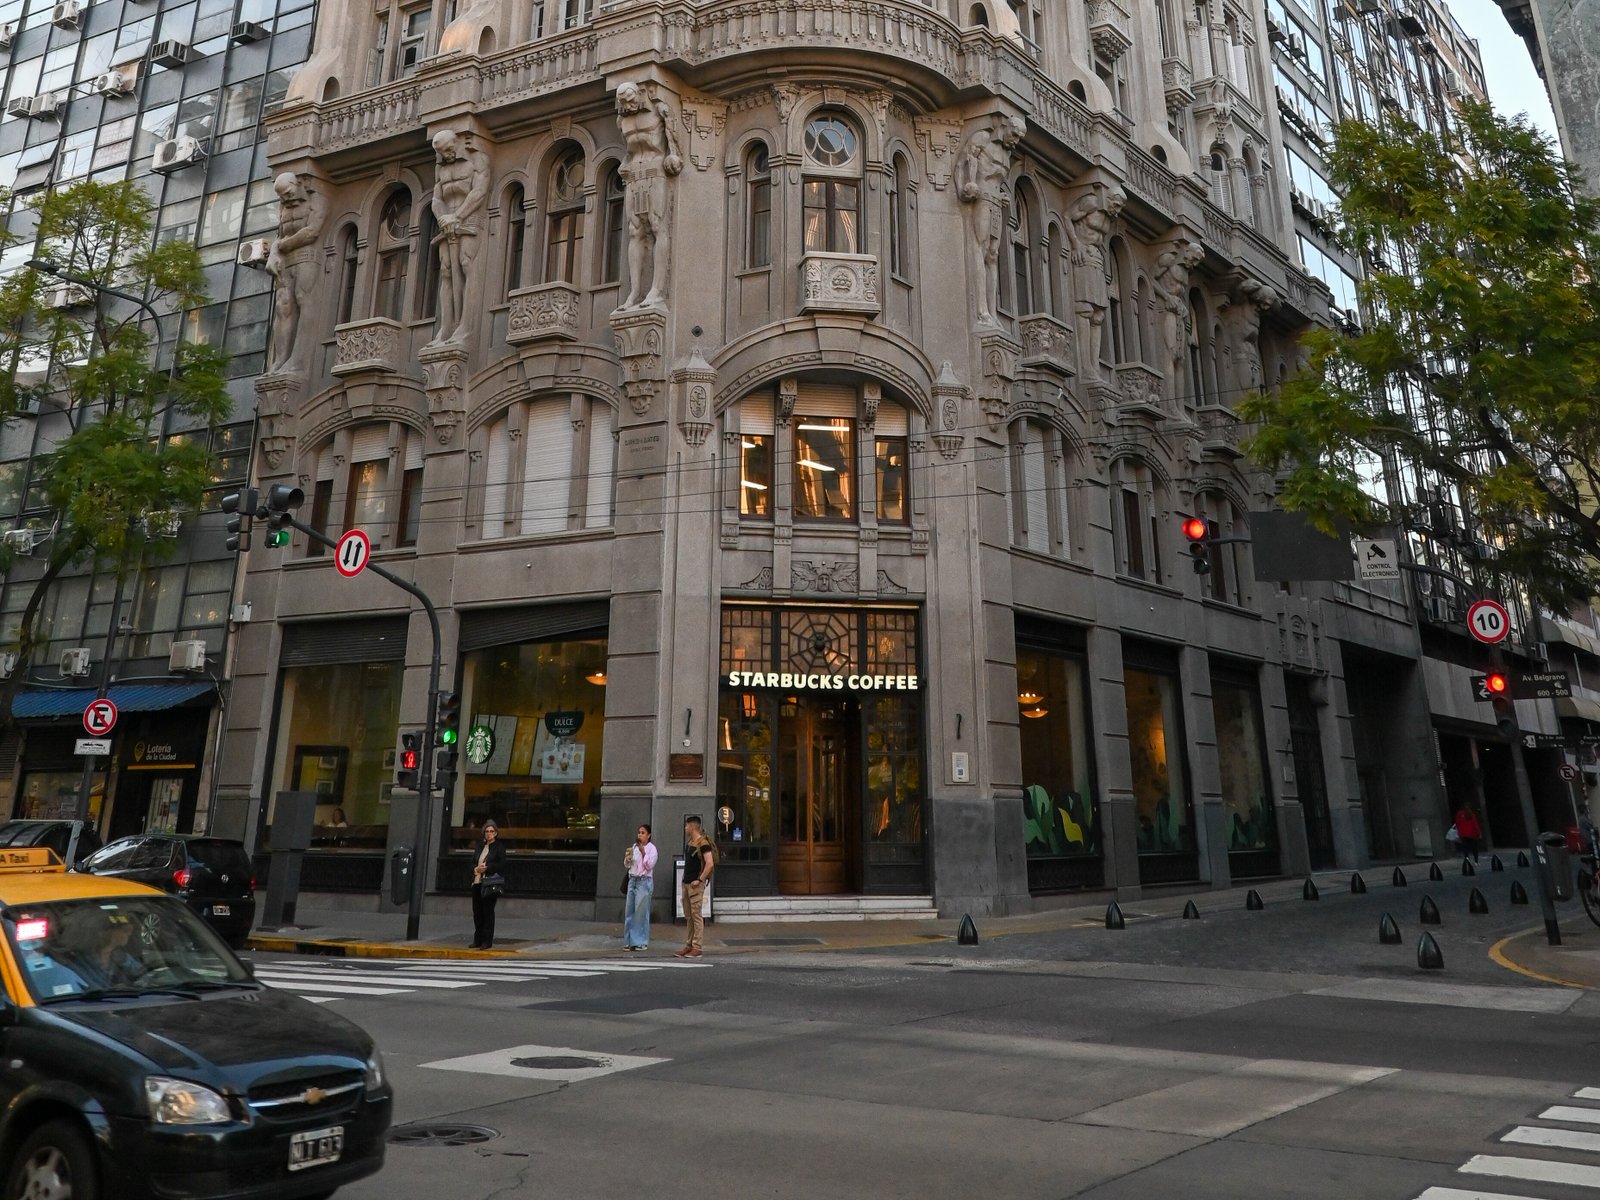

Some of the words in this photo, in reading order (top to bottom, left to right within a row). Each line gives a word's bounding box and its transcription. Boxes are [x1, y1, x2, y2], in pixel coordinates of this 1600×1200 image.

[1476, 612, 1500, 631] 10
[728, 671, 844, 690] STARBUCKS
[847, 675, 918, 690] COFFEE
[147, 743, 172, 753] Lotería
[9, 853, 29, 863] Taxi
